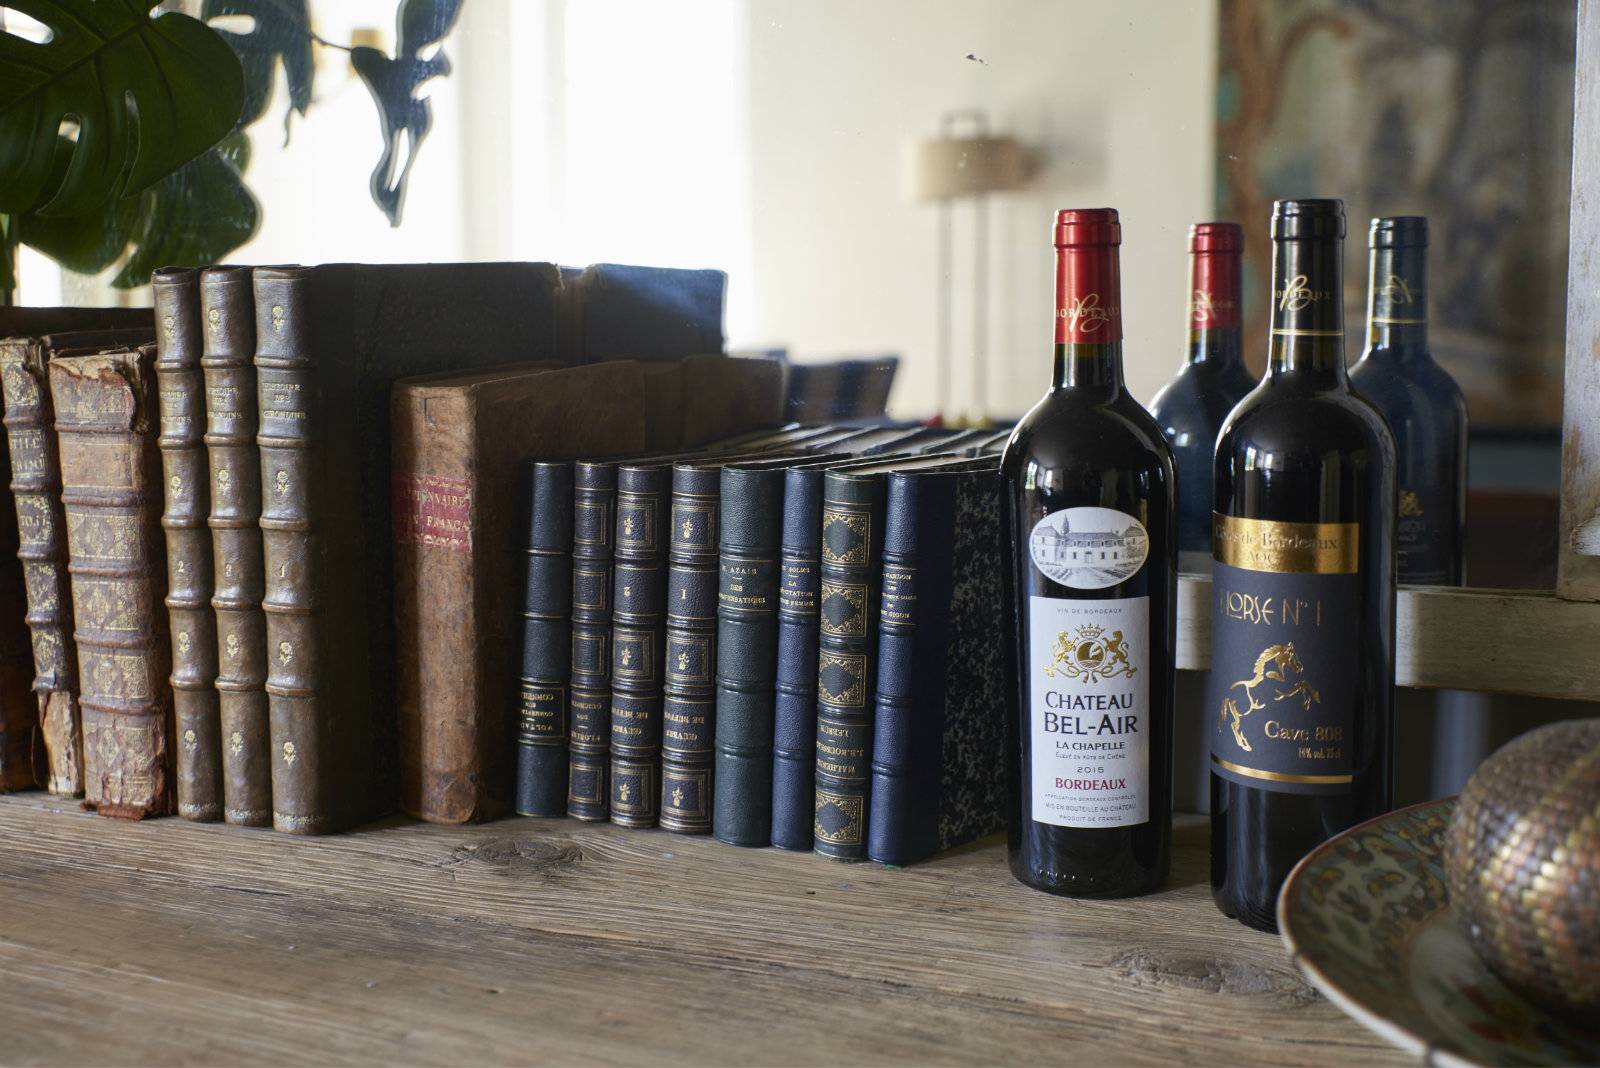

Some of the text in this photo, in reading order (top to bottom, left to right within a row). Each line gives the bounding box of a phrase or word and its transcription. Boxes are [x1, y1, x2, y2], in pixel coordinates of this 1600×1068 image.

[177, 560, 185, 573] 2
[1057, 607, 1069, 615] VIN
[1045, 691, 1133, 710] CHATEAU
[1044, 711, 1139, 736] BEL-AIR
[1264, 720, 1310, 741] Cave
[1056, 741, 1126, 751] LA CHAPELLE
[1077, 766, 1105, 774] 2015
[1055, 777, 1127, 791] BORDEAUX
[1045, 802, 1055, 810] MIS
[1066, 805, 1099, 813] BOUTEILLE
[1098, 814, 1122, 822] FRANCE
